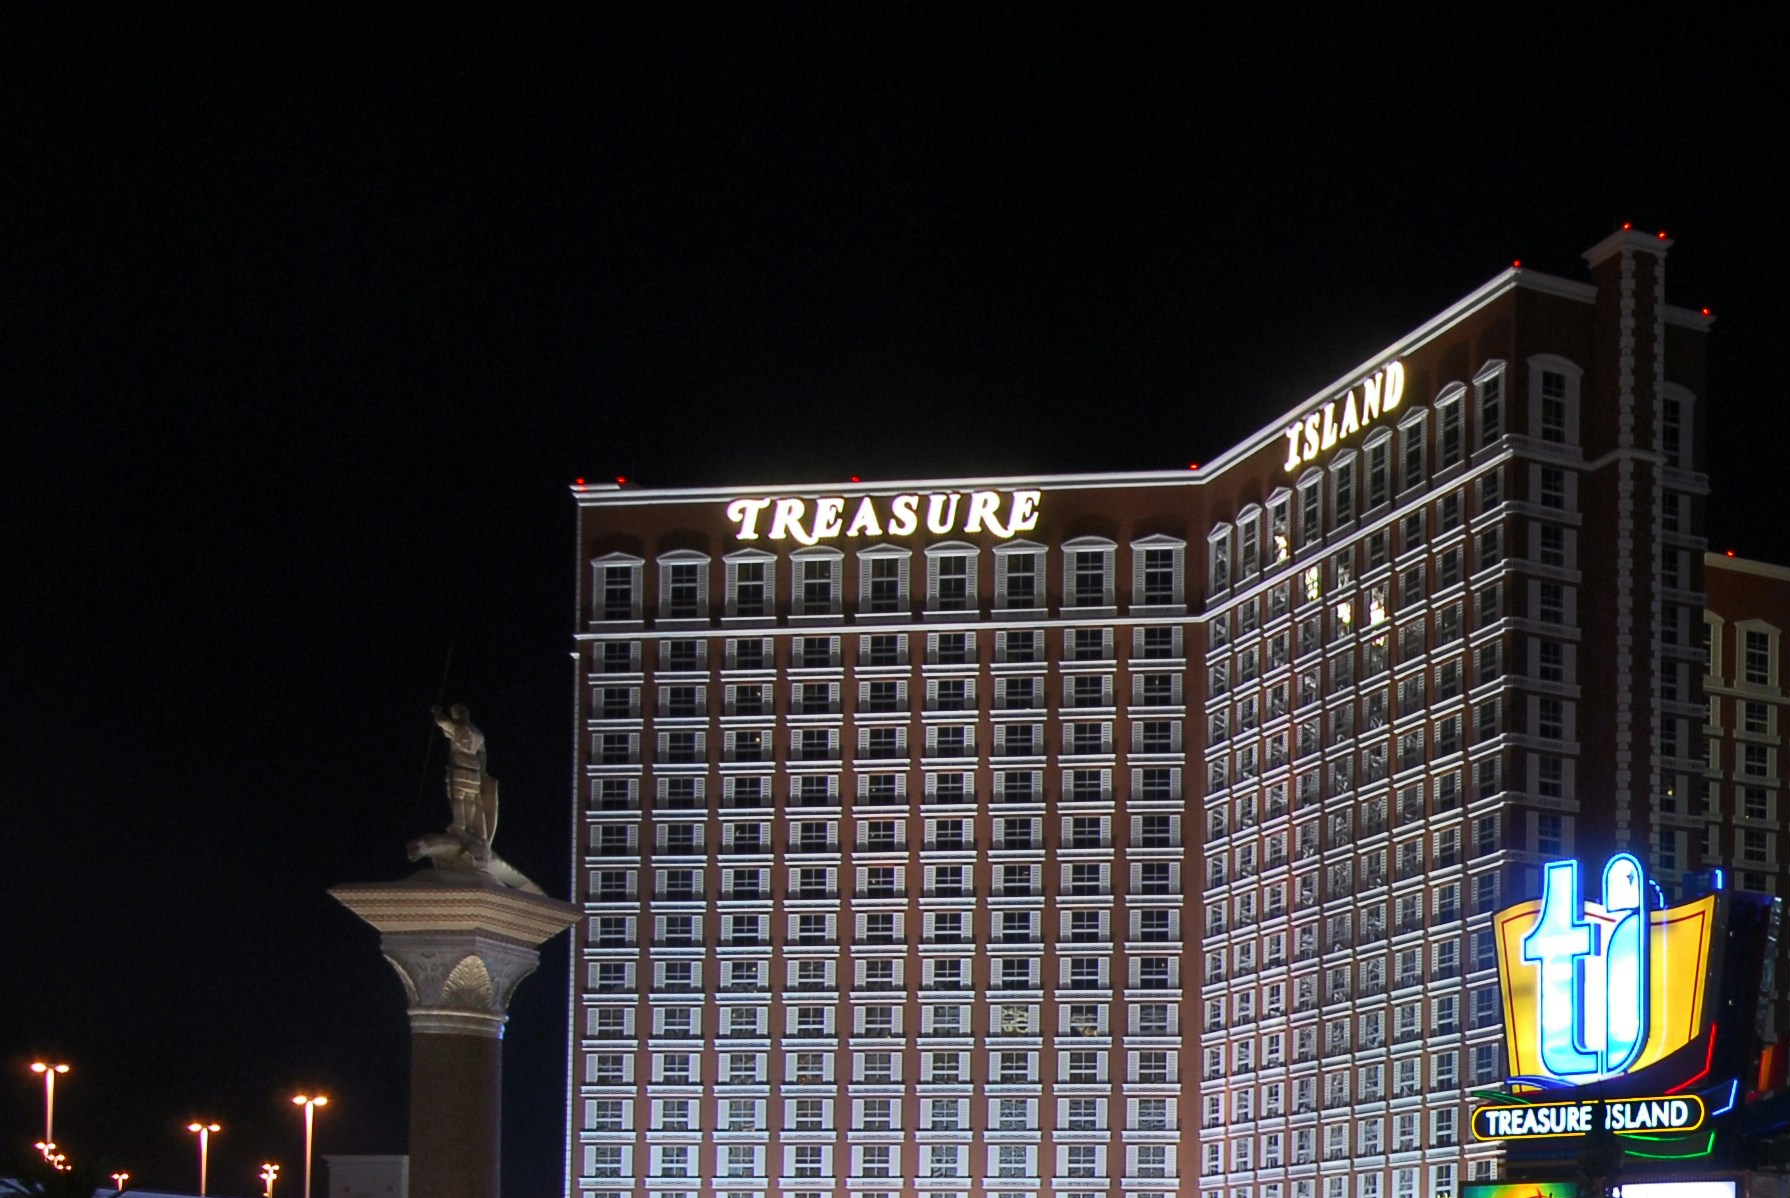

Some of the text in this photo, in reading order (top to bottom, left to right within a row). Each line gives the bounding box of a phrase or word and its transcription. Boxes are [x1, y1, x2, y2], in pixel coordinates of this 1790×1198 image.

[1284, 360, 1405, 472] ISLAND
[727, 489, 1042, 546] TREASURE
[1485, 1100, 1689, 1136] TREASURE ISLAND
